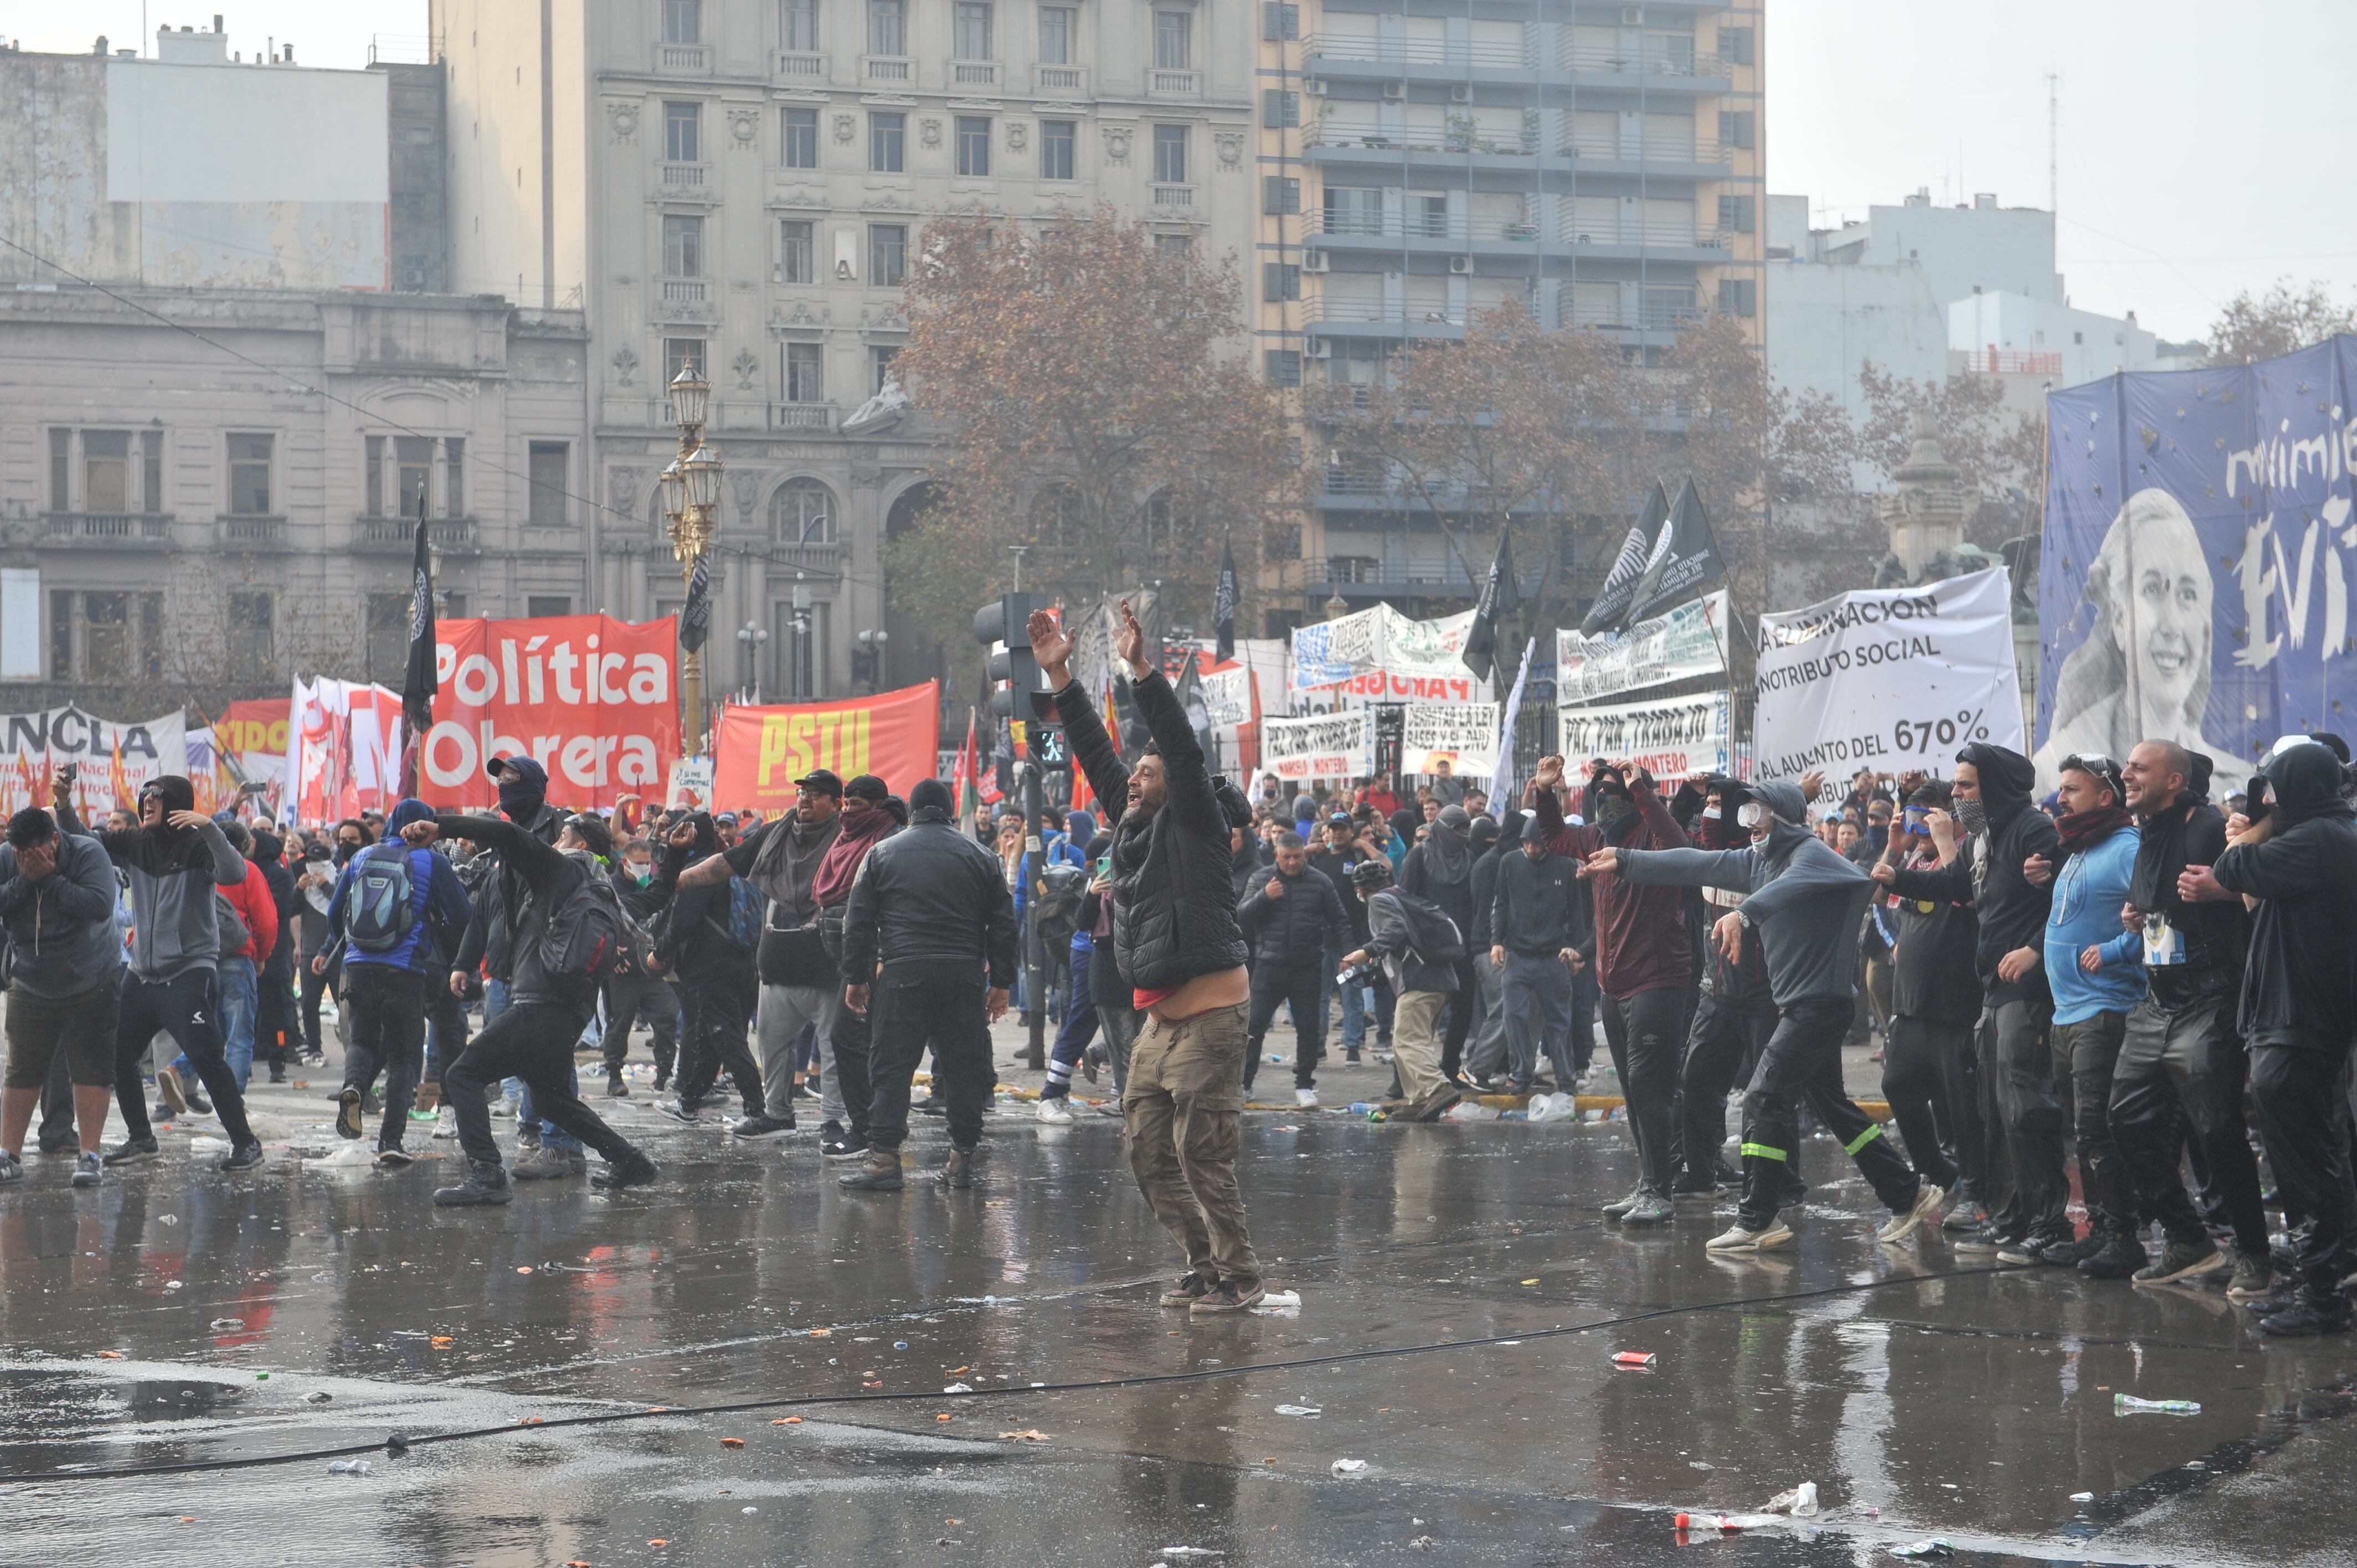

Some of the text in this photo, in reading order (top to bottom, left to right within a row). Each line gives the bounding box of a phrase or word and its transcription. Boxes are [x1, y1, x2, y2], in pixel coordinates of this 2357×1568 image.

[1761, 630, 1772, 652] A
[1774, 593, 1937, 647] ELIMINACIÓN
[430, 633, 668, 707] Política
[1759, 635, 1941, 693] NOTRIBUTO SOCIAL
[0, 709, 158, 759] NCLA
[1476, 705, 1495, 727] LEY
[1627, 704, 1708, 749] TRABAJO
[1761, 760, 1780, 780] AL
[1851, 734, 1888, 759] DEL
[1894, 708, 1989, 754] 670%
[78, 761, 146, 778] Nacinal
[425, 719, 659, 788] Obrera
[758, 709, 871, 786] PSTU
[1634, 752, 1687, 776] MONTERO
